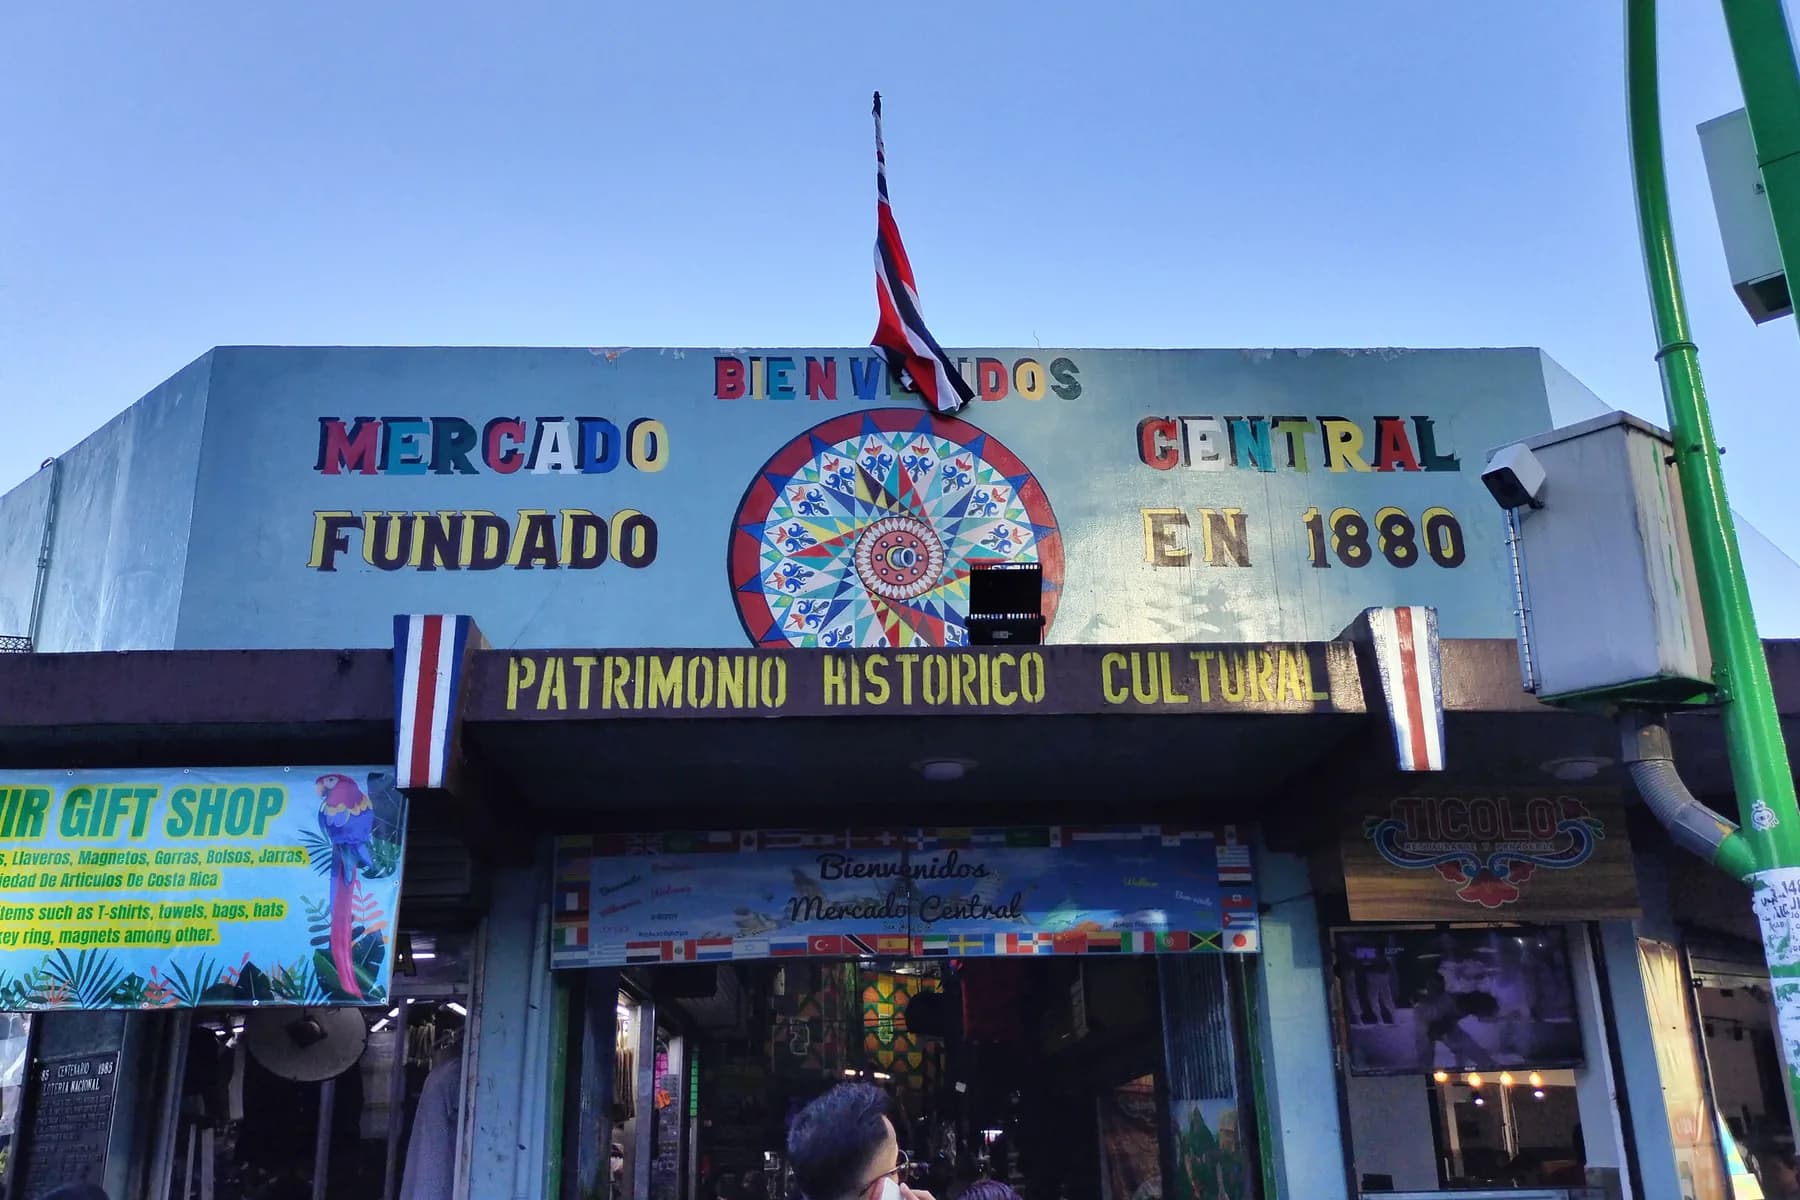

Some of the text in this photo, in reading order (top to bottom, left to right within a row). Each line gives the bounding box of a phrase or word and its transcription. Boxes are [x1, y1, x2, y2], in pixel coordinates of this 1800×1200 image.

[714, 356, 1082, 401] BIENVIDOS
[313, 415, 1461, 475] MERCADO CENTRAL
[305, 506, 1465, 572] FUNDADO EN 1880
[506, 648, 1329, 710] PATRIMONIO HISTORICO CULTURAL
[60, 788, 157, 838] GIFT
[166, 787, 284, 838] SHOP
[1393, 797, 1558, 840] TICOLO
[12, 850, 73, 867] Llaveros,
[78, 849, 149, 867] Magnetos,
[154, 850, 201, 866] Gorras,
[206, 849, 254, 865] Bolsos,
[258, 848, 307, 865] Jarras,
[817, 851, 990, 880] Bienvenidos
[40, 873, 57, 888] De
[60, 871, 122, 888] Articulos
[128, 872, 144, 887] De
[147, 871, 186, 888] Costa
[189, 870, 218, 887] Rica
[39, 905, 73, 920] such
[77, 908, 94, 920] as
[98, 903, 155, 921] T-shirts,
[159, 903, 206, 920] towels,
[212, 902, 249, 920] bags,
[253, 902, 284, 918] hats
[788, 892, 1025, 923] Mercado Central
[23, 927, 54, 946] ring,
[59, 929, 121, 947] magnets
[125, 928, 172, 946] among
[175, 926, 215, 944] other.
[70, 1077, 100, 1094] NACIONAL
